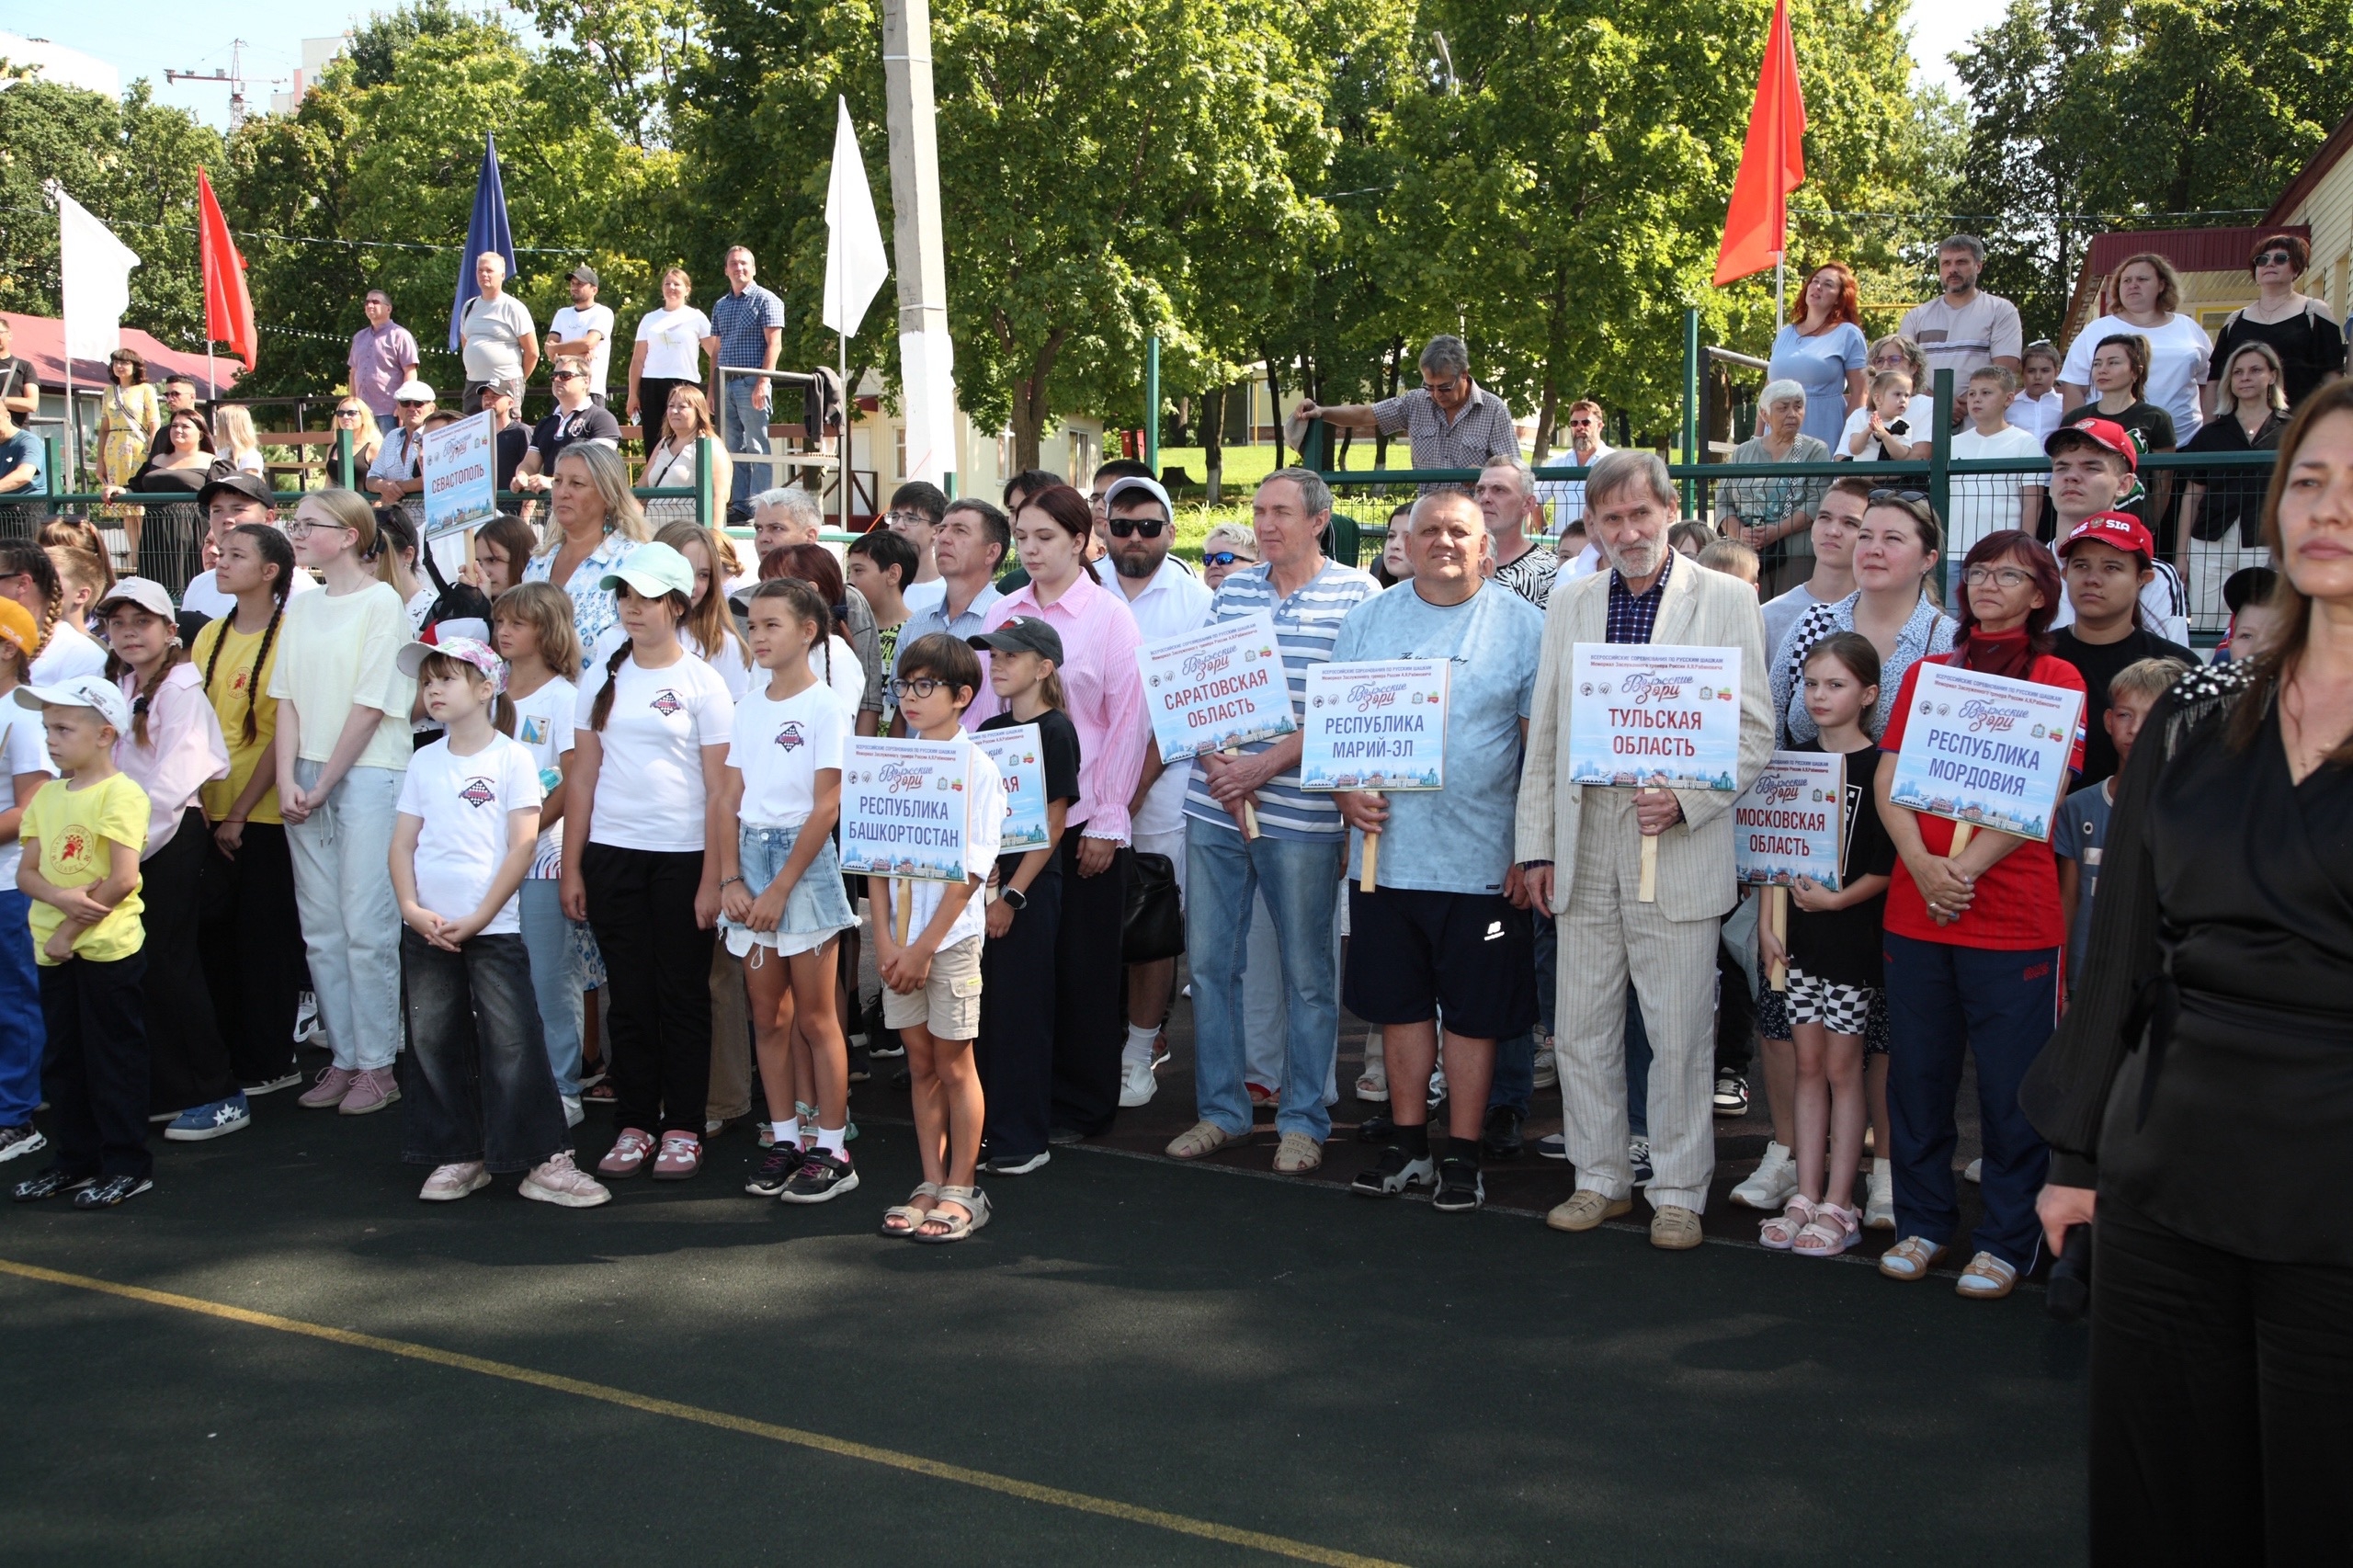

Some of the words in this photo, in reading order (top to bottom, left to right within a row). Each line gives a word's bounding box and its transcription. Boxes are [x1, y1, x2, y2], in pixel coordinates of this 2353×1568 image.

[432, 463, 484, 494] СЕВАСТОПОЛЬ
[2105, 519, 2130, 532] SIA
[1164, 669, 1268, 710] САРАТОВСКАЯ
[1188, 698, 1255, 728] ОБЛАСТЬ
[1326, 715, 1424, 734] РЕСПУБЛИКА
[1608, 708, 1701, 730] ТУЛЬСКАЯ
[1333, 737, 1413, 758] МАРИЙ-ЭЛ
[1613, 735, 1695, 757] ОБЛАСТЬ
[1928, 729, 2040, 770] РЕСПУБЛИКА
[1929, 758, 2026, 796] МОРДОВИЯ
[860, 796, 948, 820] РЕСПУБЛИКА
[1736, 808, 1825, 831] МОСКОВСКАЯ
[849, 821, 958, 847] БАШКОРТОСТАН
[1750, 834, 1810, 856] ОБЛАСТЬ
